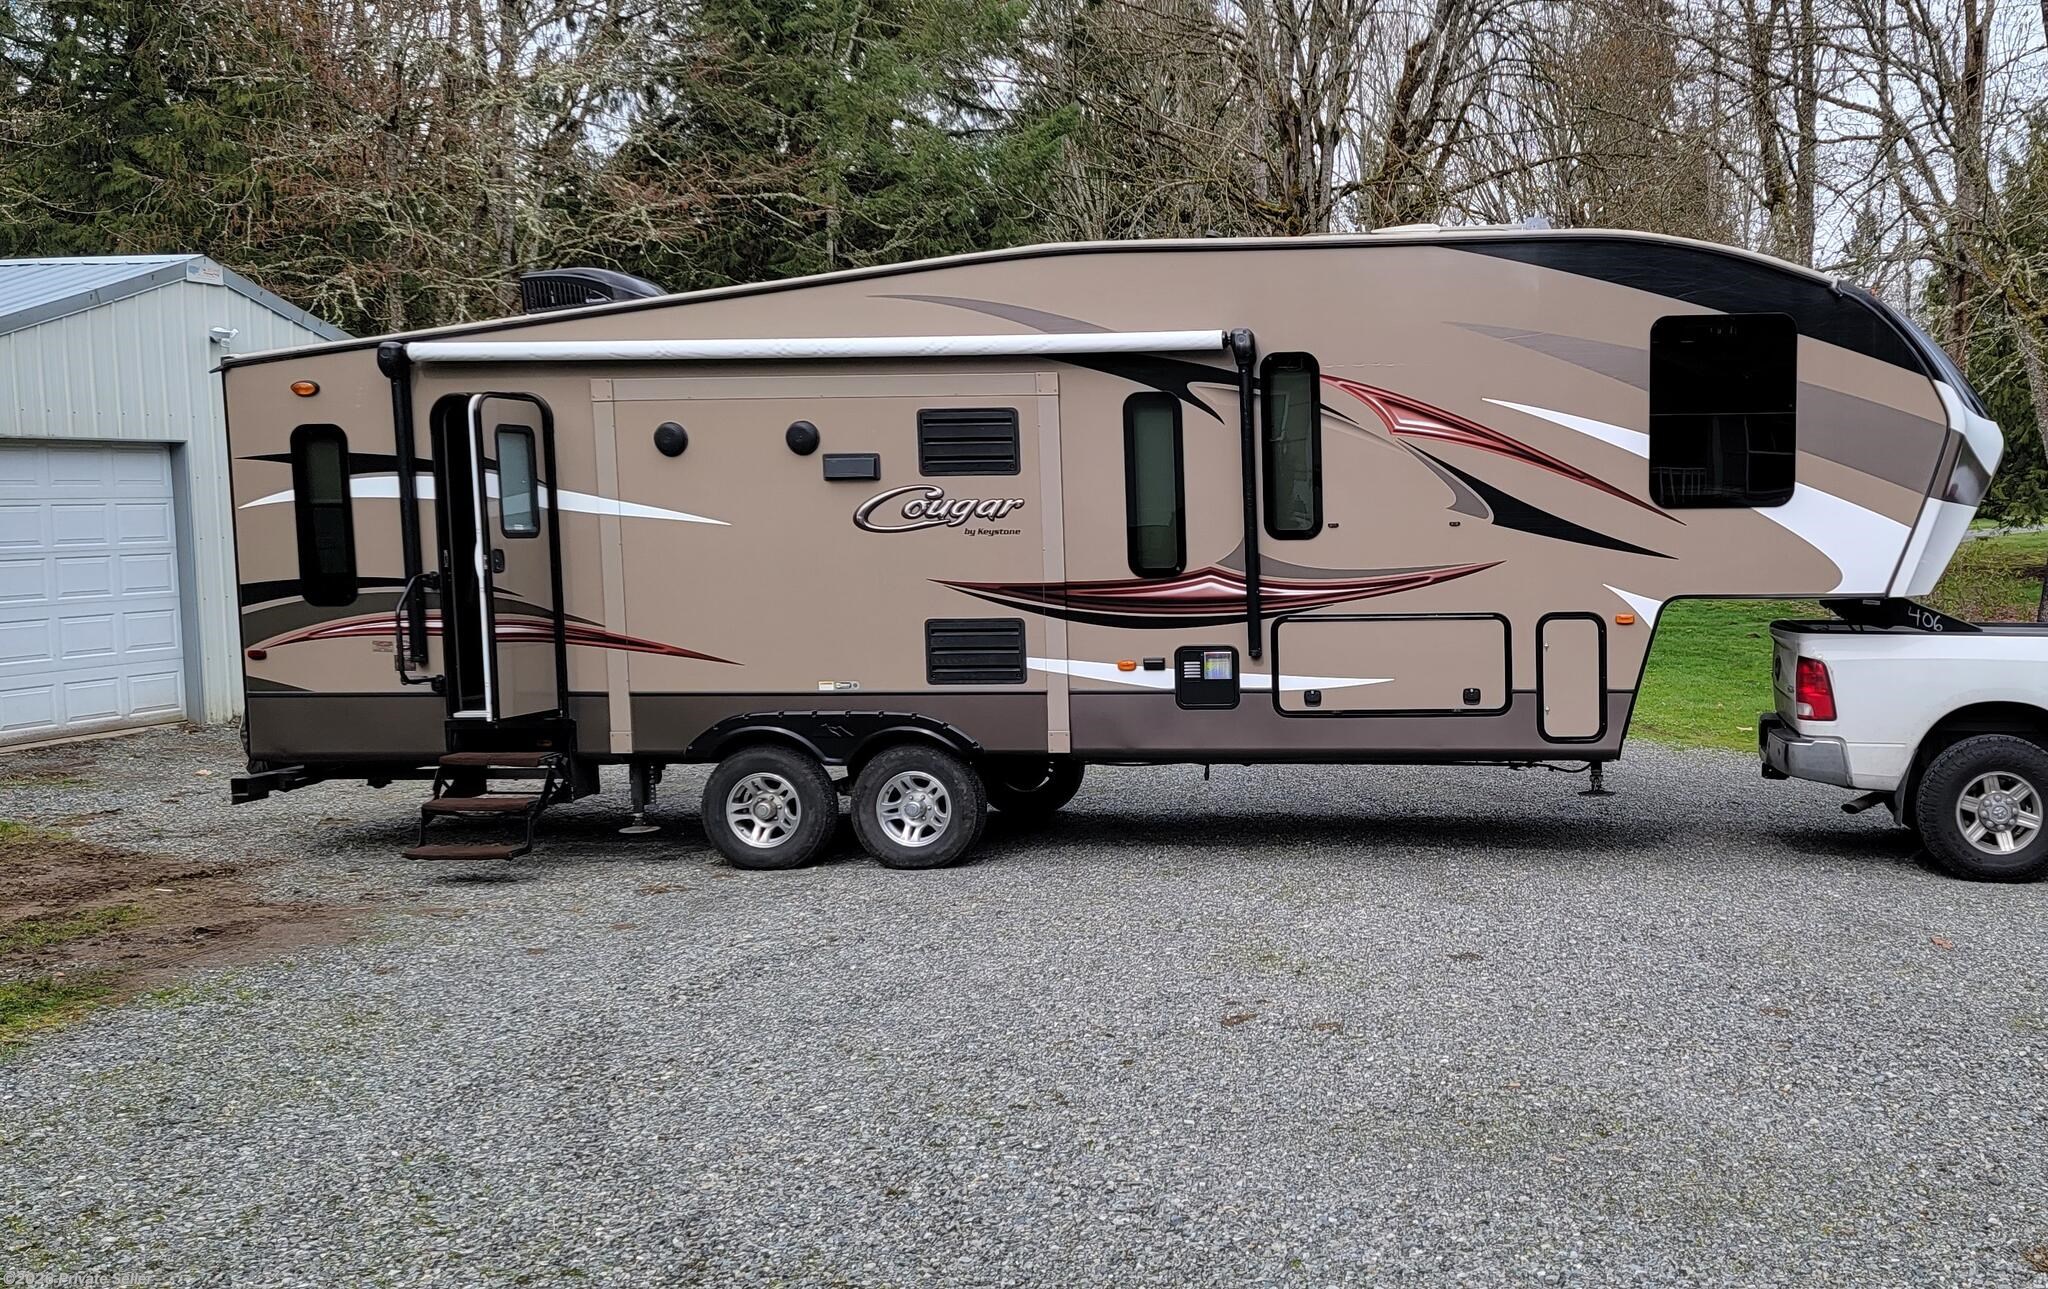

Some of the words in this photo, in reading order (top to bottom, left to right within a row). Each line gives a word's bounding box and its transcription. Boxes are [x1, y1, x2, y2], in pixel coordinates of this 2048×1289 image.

[853, 484, 1025, 533] Cougar
[964, 528, 975, 537] by
[977, 528, 1021, 537] Keystone
[1908, 606, 1943, 632] 406
